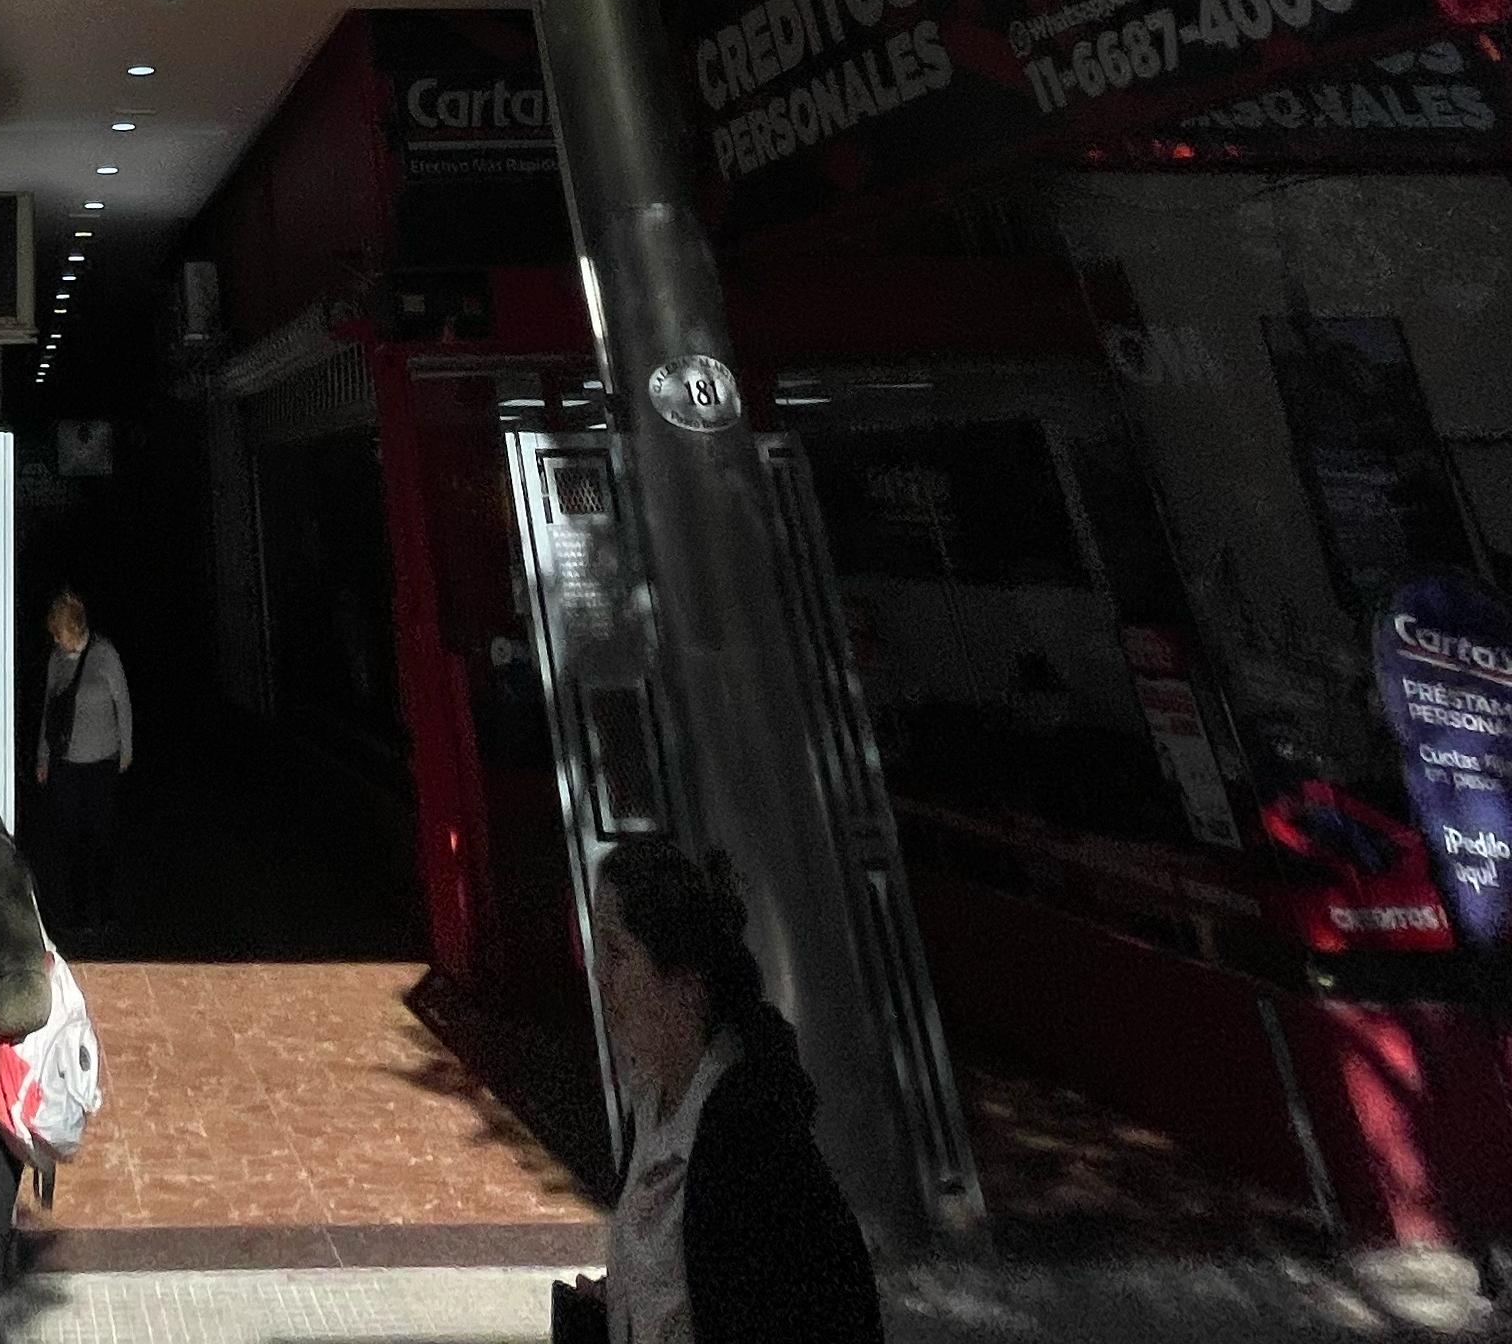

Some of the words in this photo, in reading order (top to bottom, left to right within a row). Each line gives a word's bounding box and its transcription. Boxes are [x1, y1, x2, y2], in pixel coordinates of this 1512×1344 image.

[406, 77, 548, 127] Carta
[711, 19, 954, 181] PERSONALES
[684, 380, 721, 406] 181
